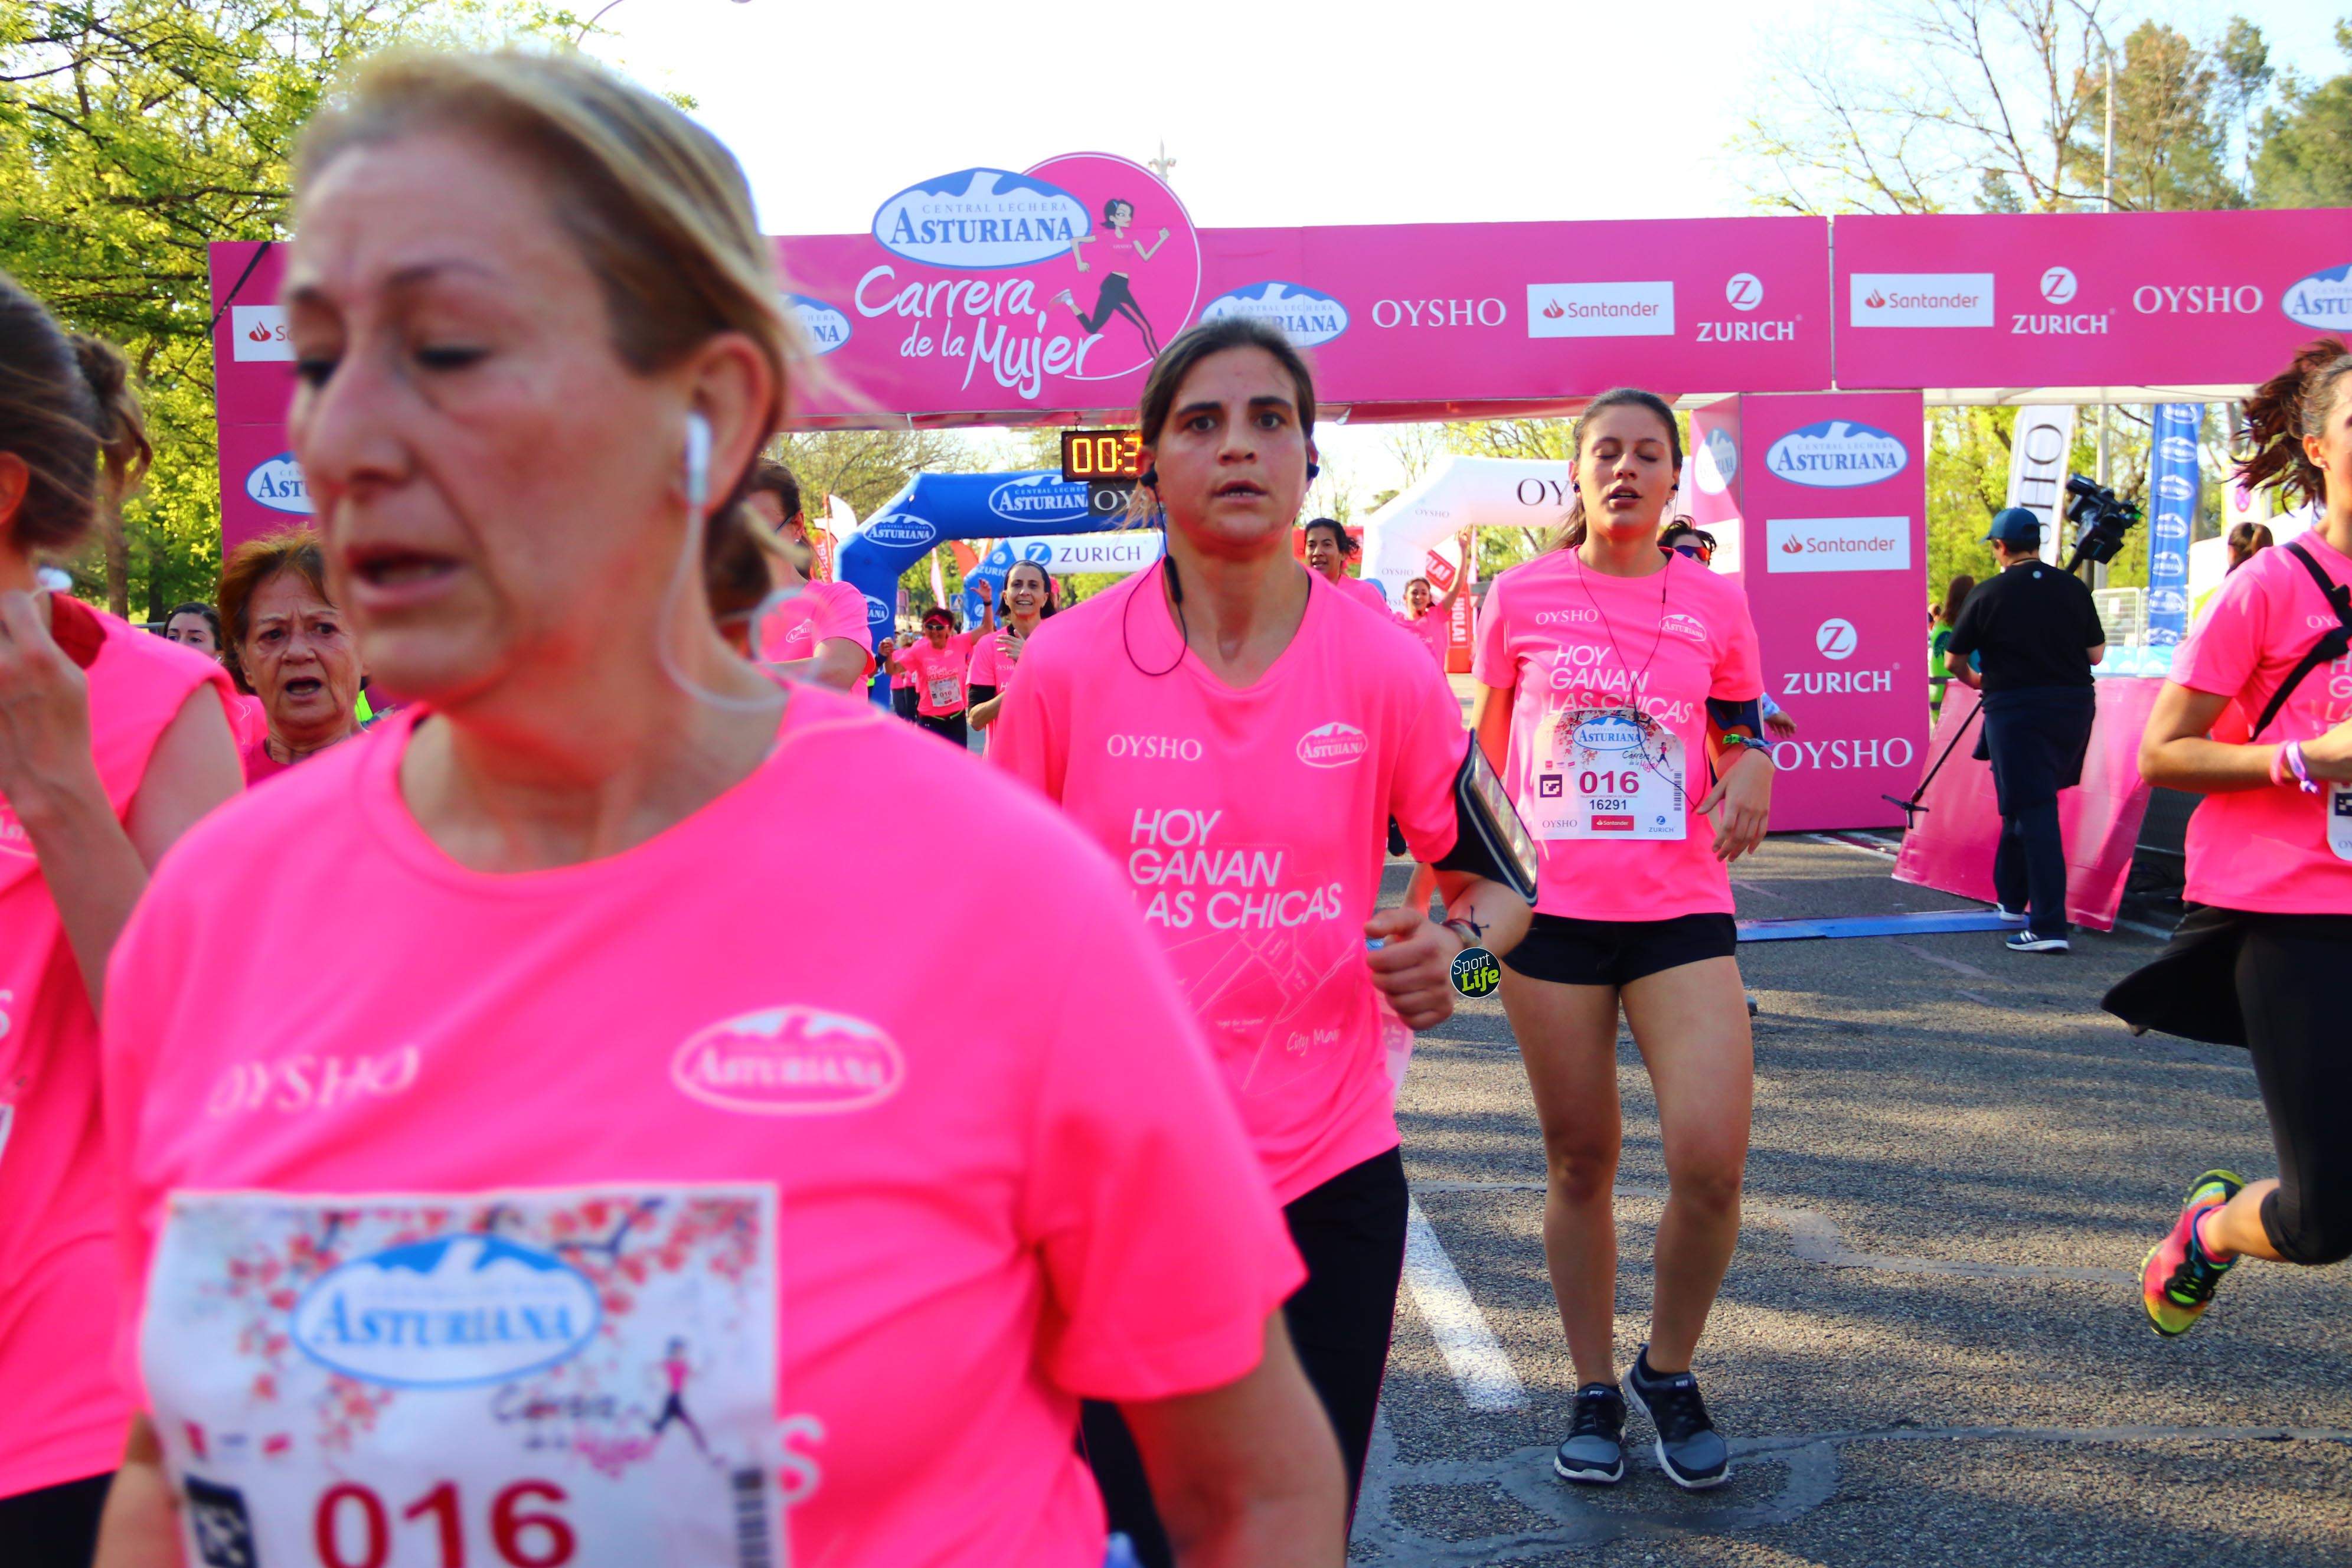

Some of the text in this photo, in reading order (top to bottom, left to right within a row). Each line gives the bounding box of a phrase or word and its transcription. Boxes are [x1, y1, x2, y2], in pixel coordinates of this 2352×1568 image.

[889, 207, 1074, 244] ASTURIANA
[854, 265, 1035, 319] Carrera
[1889, 293, 1979, 309] Santander
[2132, 285, 2263, 314] OYSHO
[1371, 298, 1507, 329] OYSHO
[1567, 300, 1660, 318] Santander
[1696, 321, 1795, 342] ZURICH
[2010, 313, 2109, 335] ZURICH
[900, 312, 1105, 400] de la Mujer
[1775, 446, 1899, 472] ASTURIANA
[257, 471, 308, 498] AST
[1415, 508, 1450, 518] OYSHO
[867, 526, 930, 540] ASTURIANA
[1805, 536, 1896, 554] Santander
[1059, 545, 1142, 563] ZURICH
[1381, 567, 1414, 576] OYSHO
[1535, 609, 1599, 626] OYSHO
[1553, 645, 1611, 667] HOY
[1549, 667, 1649, 693] GANAN
[1782, 669, 1892, 695] ZURICH
[1547, 691, 1694, 724] LAS CHICAS
[1107, 734, 1202, 761] OYSHO
[1578, 729, 1641, 742] ASTURIANA
[1772, 737, 1913, 772] OYSHO
[1579, 770, 1639, 794] 016
[1589, 799, 1627, 811] 16291
[1130, 808, 1223, 846] HOY
[1542, 819, 1578, 828] OYSHO
[1128, 849, 1282, 888] GANAN
[1132, 883, 1342, 930] AS CHICAS
[312, 1288, 579, 1348] ASTURIANA
[313, 1479, 577, 1568] 016
